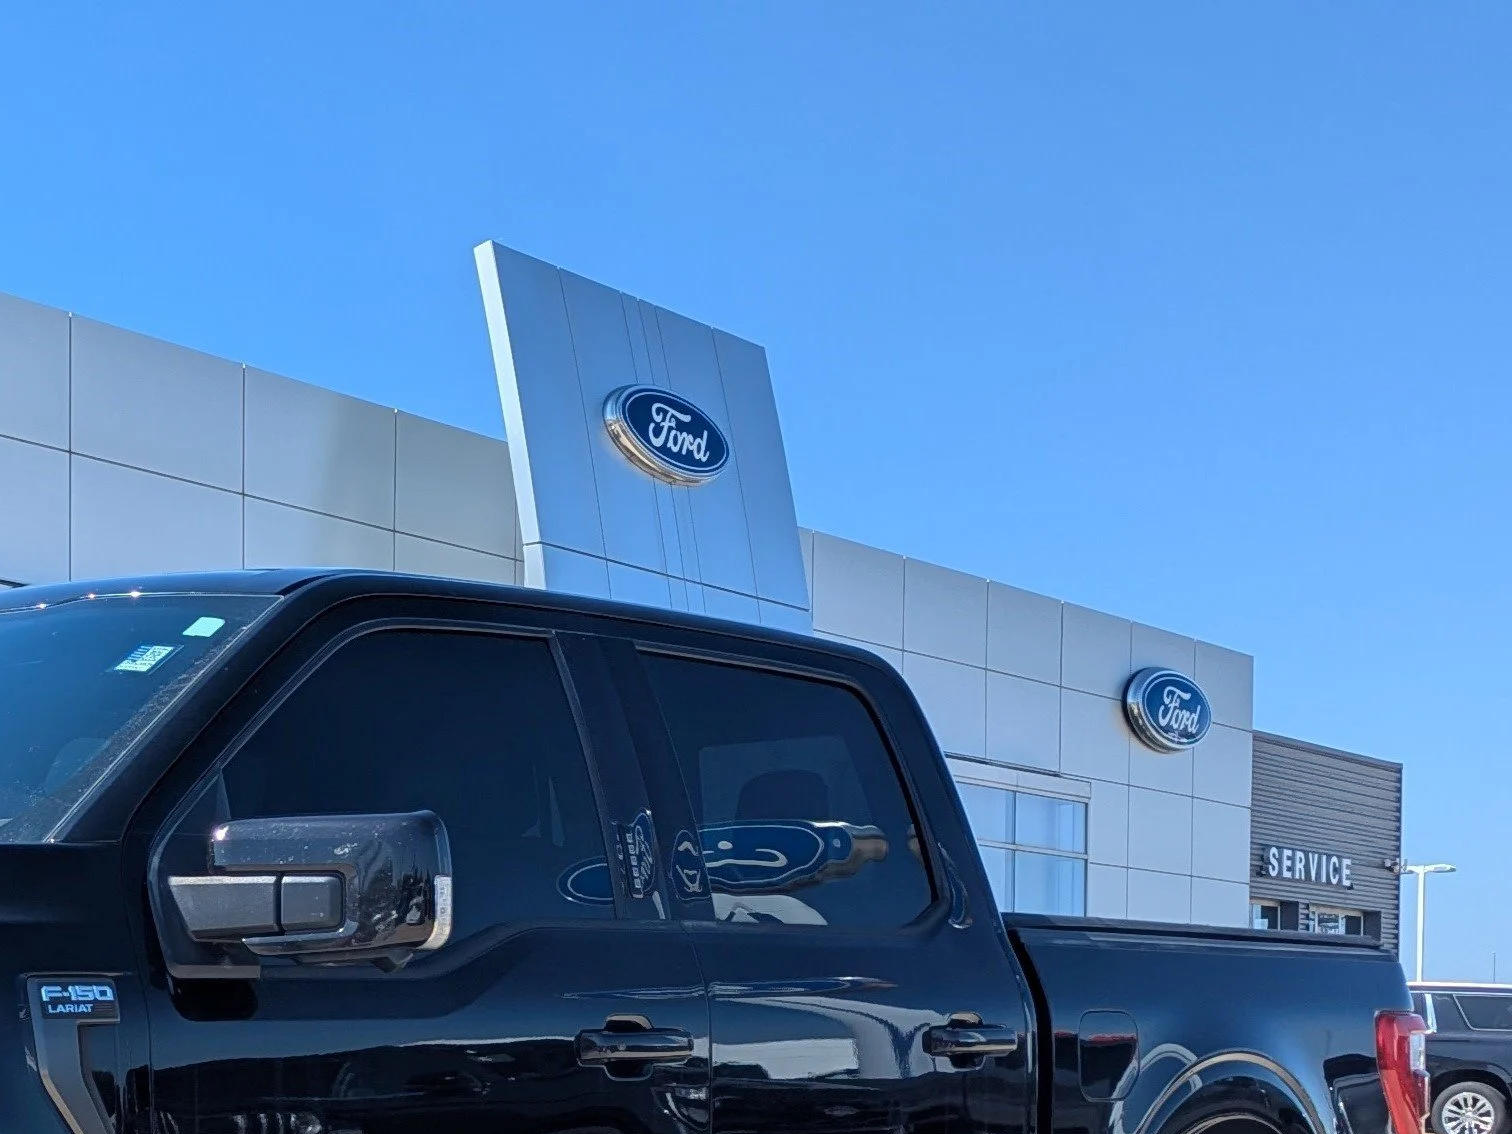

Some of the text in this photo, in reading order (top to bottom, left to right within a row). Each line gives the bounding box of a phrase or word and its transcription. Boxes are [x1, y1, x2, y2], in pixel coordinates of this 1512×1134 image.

[649, 402, 710, 463] Ford
[1158, 686, 1201, 734] Ford
[1268, 846, 1352, 887] SERVICE
[40, 985, 115, 1001] F-150
[48, 1003, 93, 1013] LARIAT
